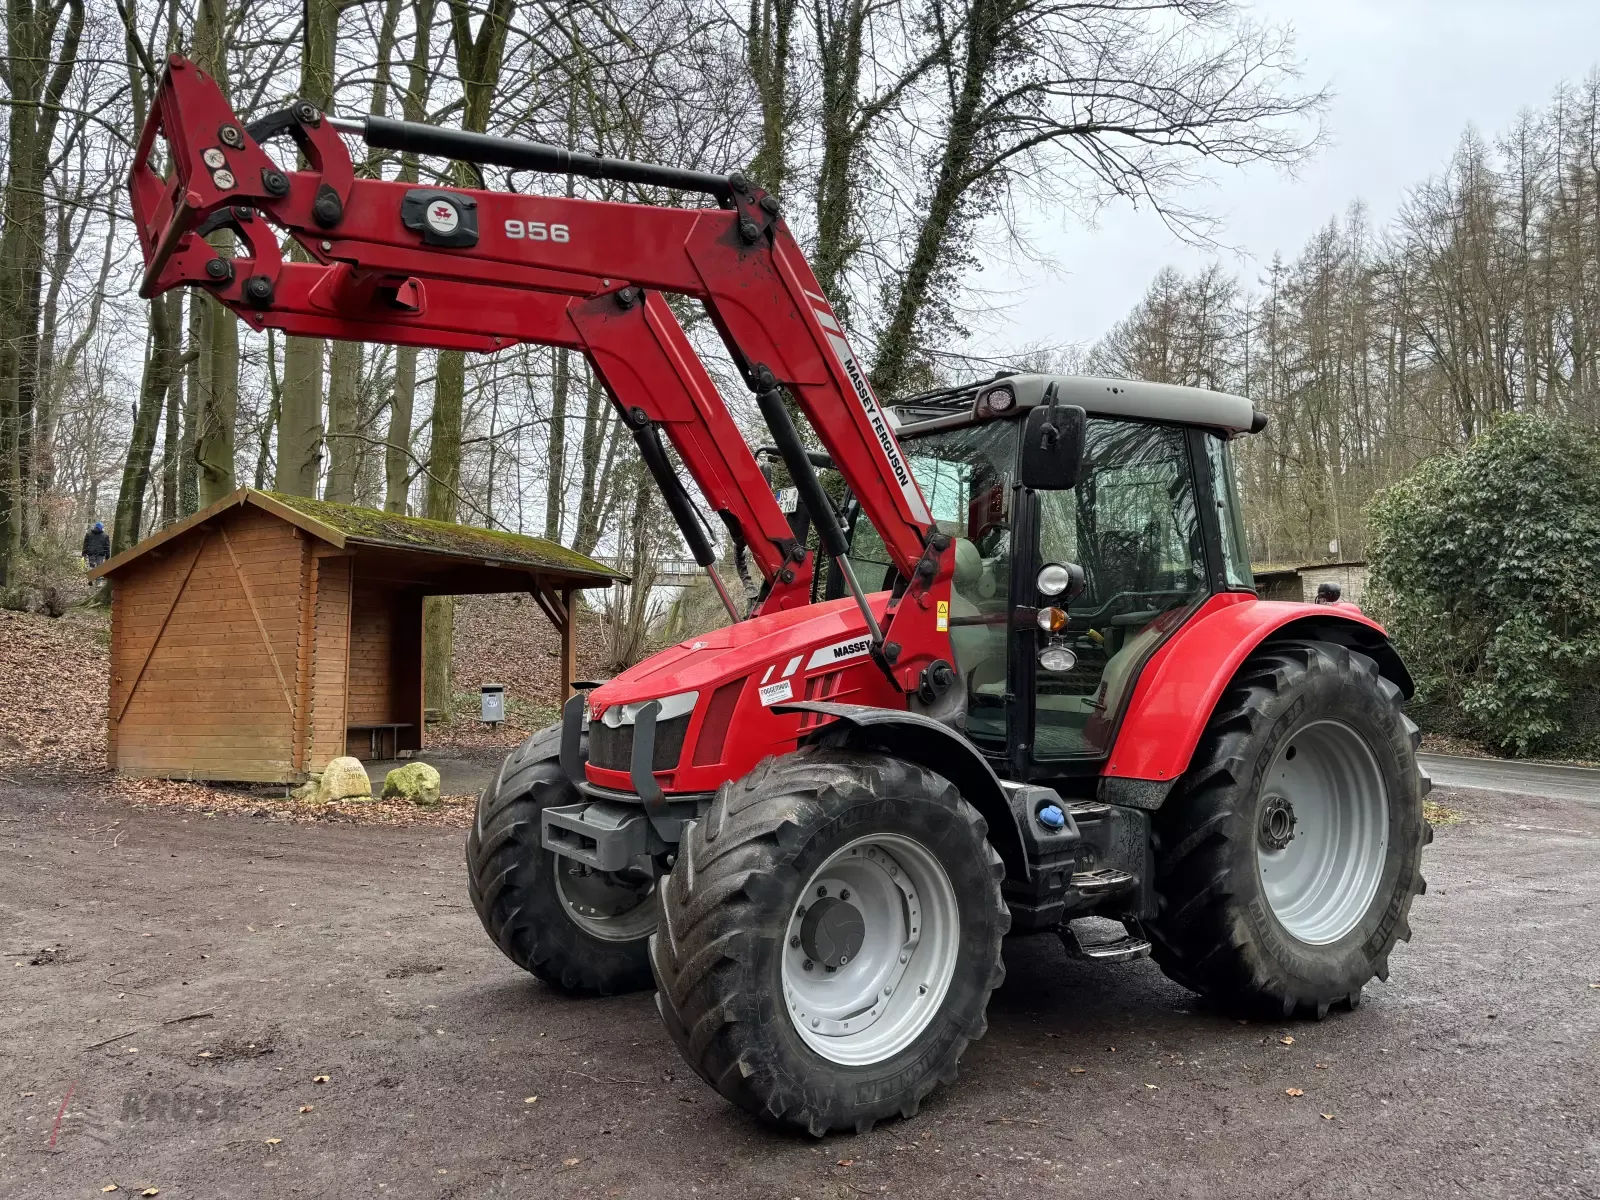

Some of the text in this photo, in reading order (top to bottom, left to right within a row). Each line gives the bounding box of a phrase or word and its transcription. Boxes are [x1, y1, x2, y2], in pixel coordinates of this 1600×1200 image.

[504, 219, 570, 243] 956
[844, 358, 909, 487] MASSEY FERGUSON
[833, 639, 871, 658] MASSEY
